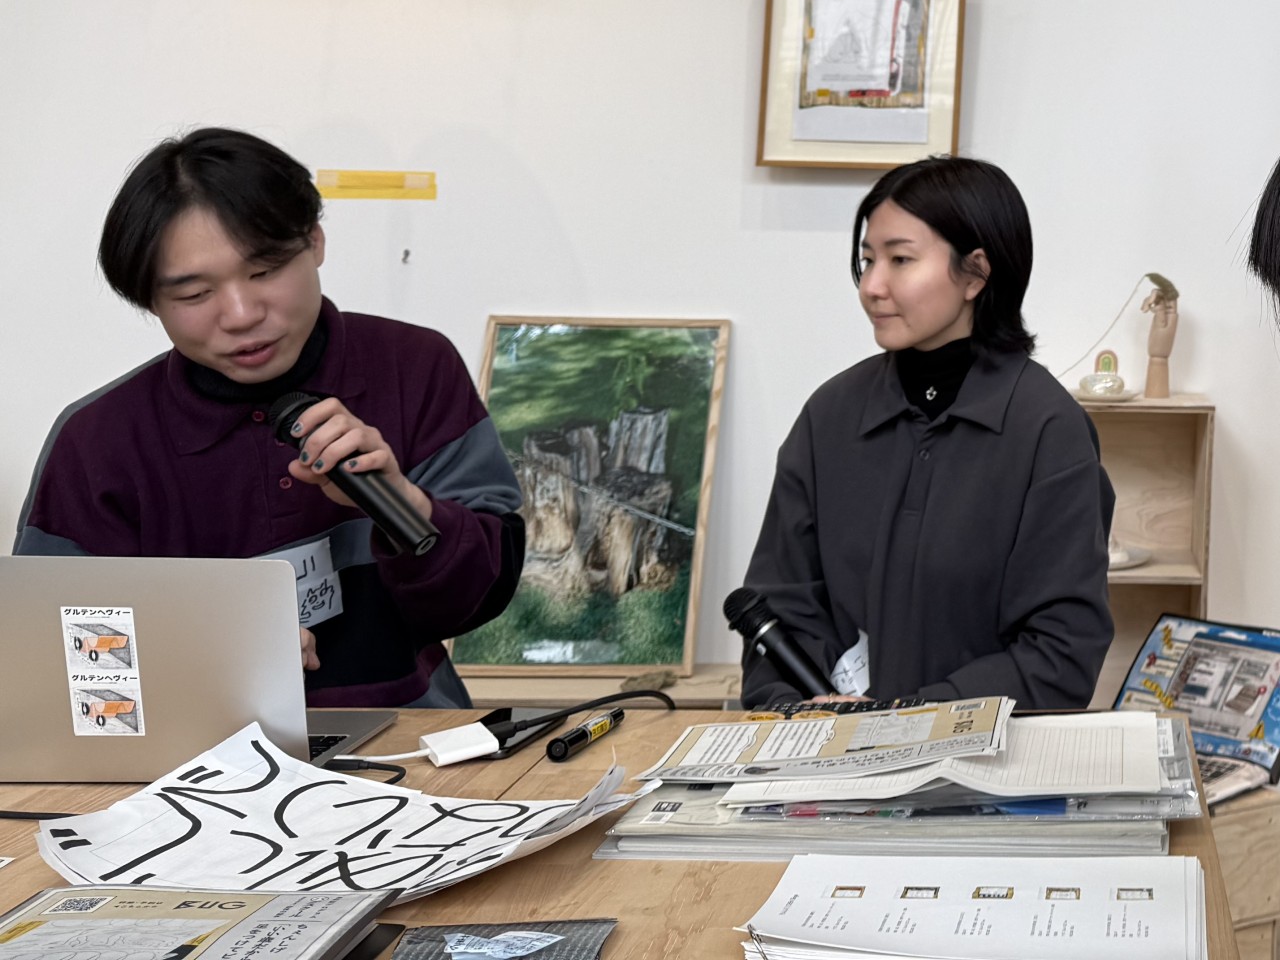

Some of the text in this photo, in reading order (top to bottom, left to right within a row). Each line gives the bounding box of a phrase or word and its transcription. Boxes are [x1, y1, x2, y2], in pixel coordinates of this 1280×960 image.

[63, 608, 131, 616] グルテンヘヴィー
[71, 674, 138, 682] グルテンヘヴィー
